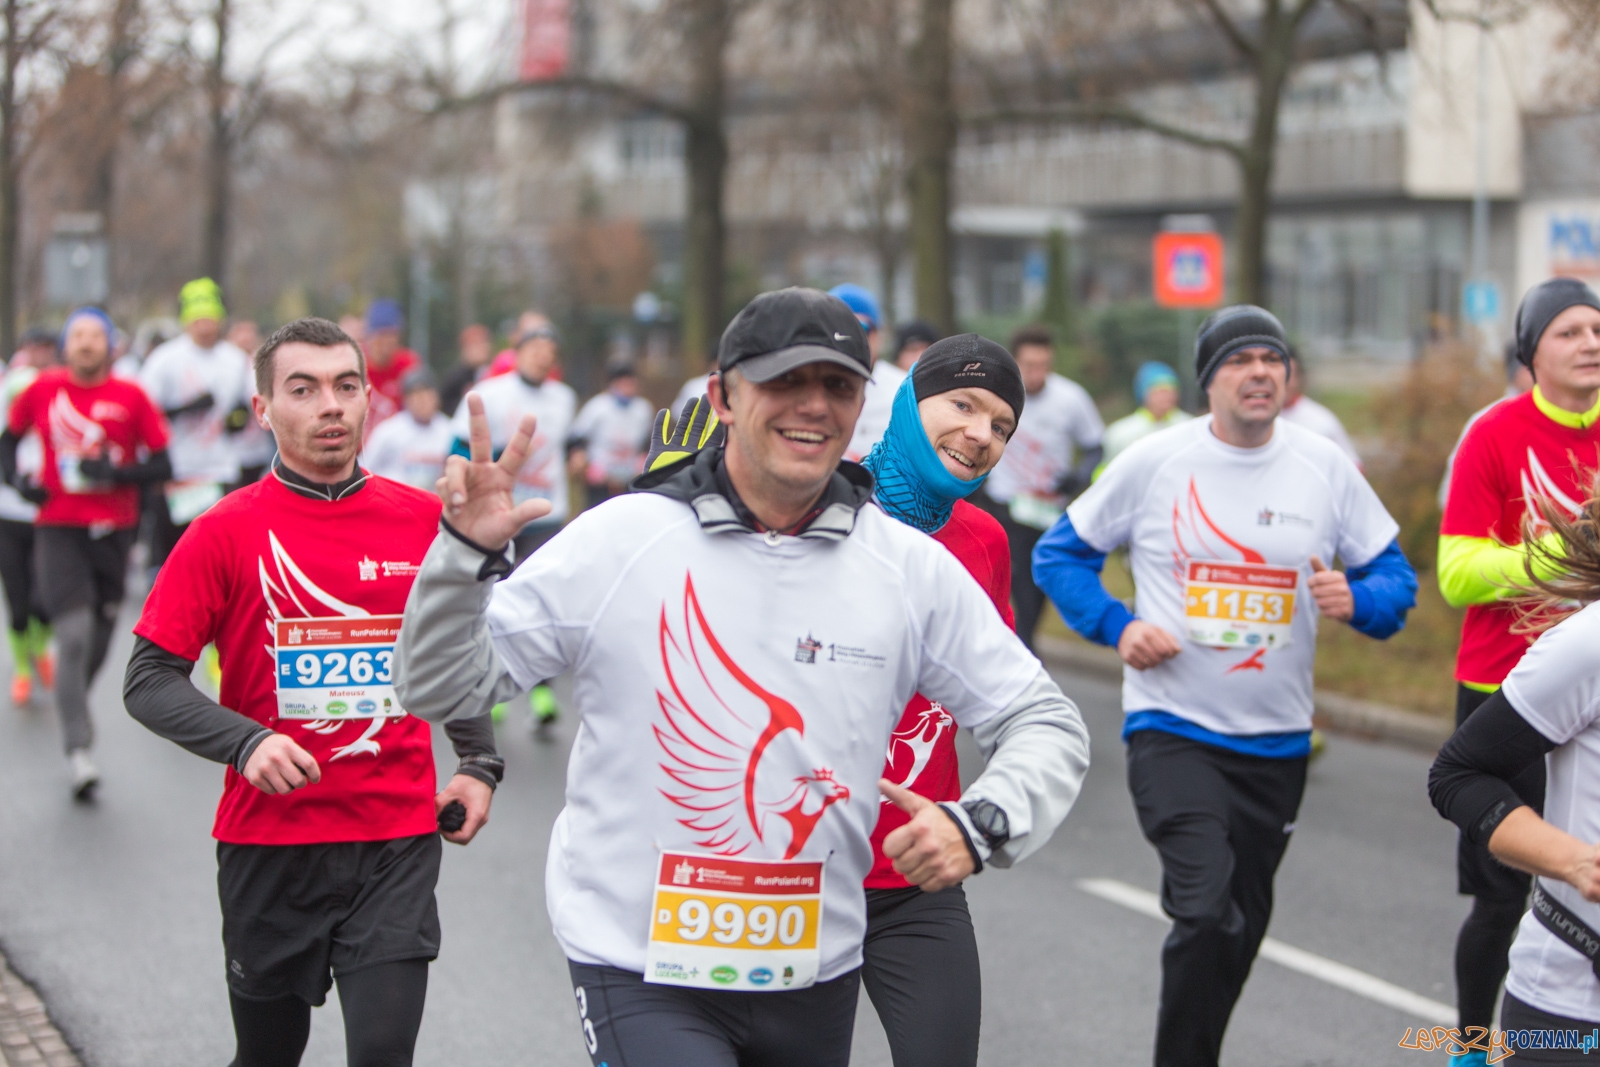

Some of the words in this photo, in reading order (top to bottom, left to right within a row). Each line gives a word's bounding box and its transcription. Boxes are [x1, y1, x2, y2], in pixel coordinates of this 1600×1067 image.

[1201, 588, 1285, 622] 1153
[280, 663, 291, 676] E
[295, 650, 393, 686] 9263
[329, 689, 366, 698] Mateusz
[657, 908, 672, 925] D
[676, 898, 807, 947] 9990
[1551, 911, 1599, 955] running
